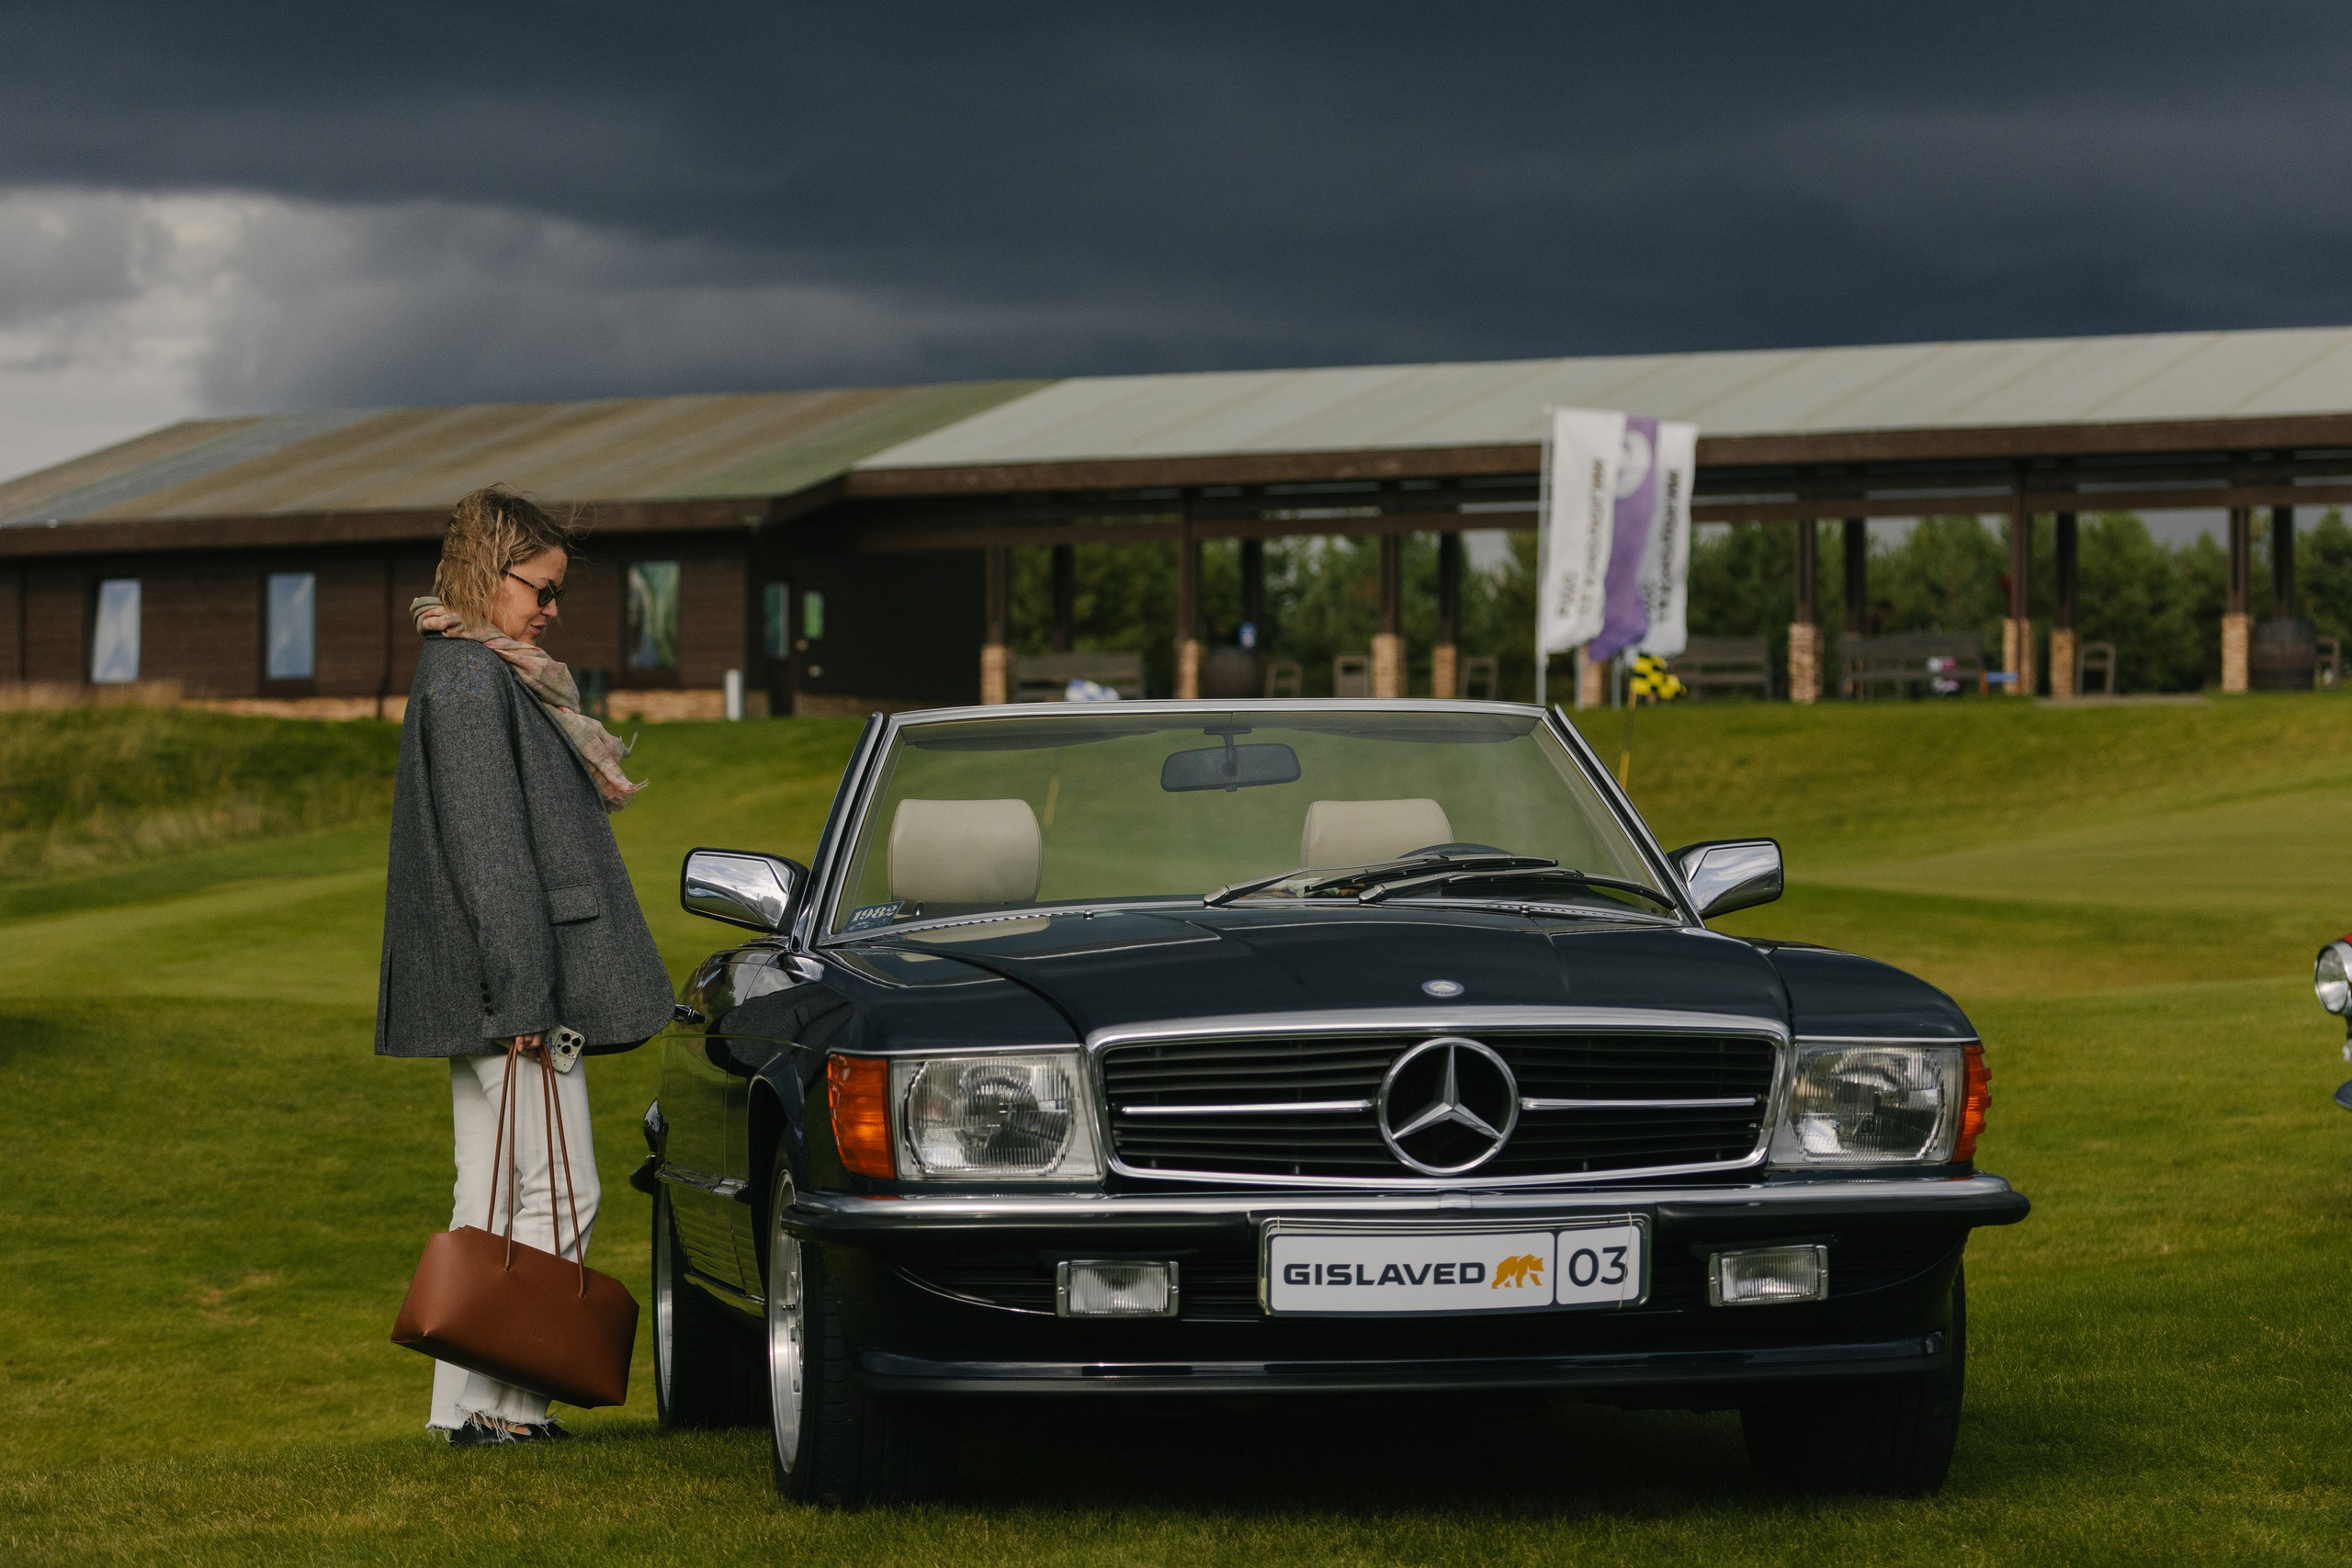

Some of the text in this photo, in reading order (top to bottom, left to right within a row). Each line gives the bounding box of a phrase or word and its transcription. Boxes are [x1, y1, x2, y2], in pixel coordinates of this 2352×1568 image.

[852, 905, 898, 922] 1982
[1283, 1246, 1629, 1288] GISLAVED 03
